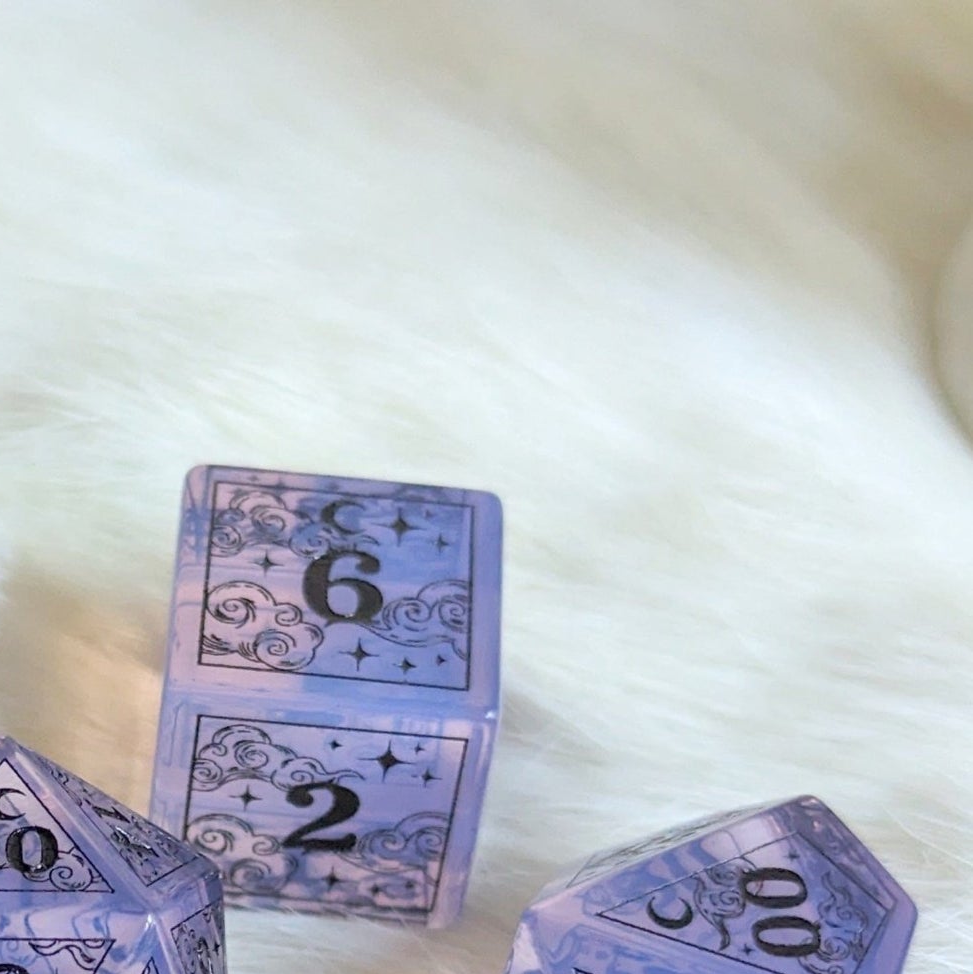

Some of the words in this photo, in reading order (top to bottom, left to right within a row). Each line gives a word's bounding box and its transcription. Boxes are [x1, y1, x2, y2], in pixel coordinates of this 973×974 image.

[302, 549, 384, 624] 6
[281, 783, 361, 851] 2
[740, 866, 822, 958] 00
